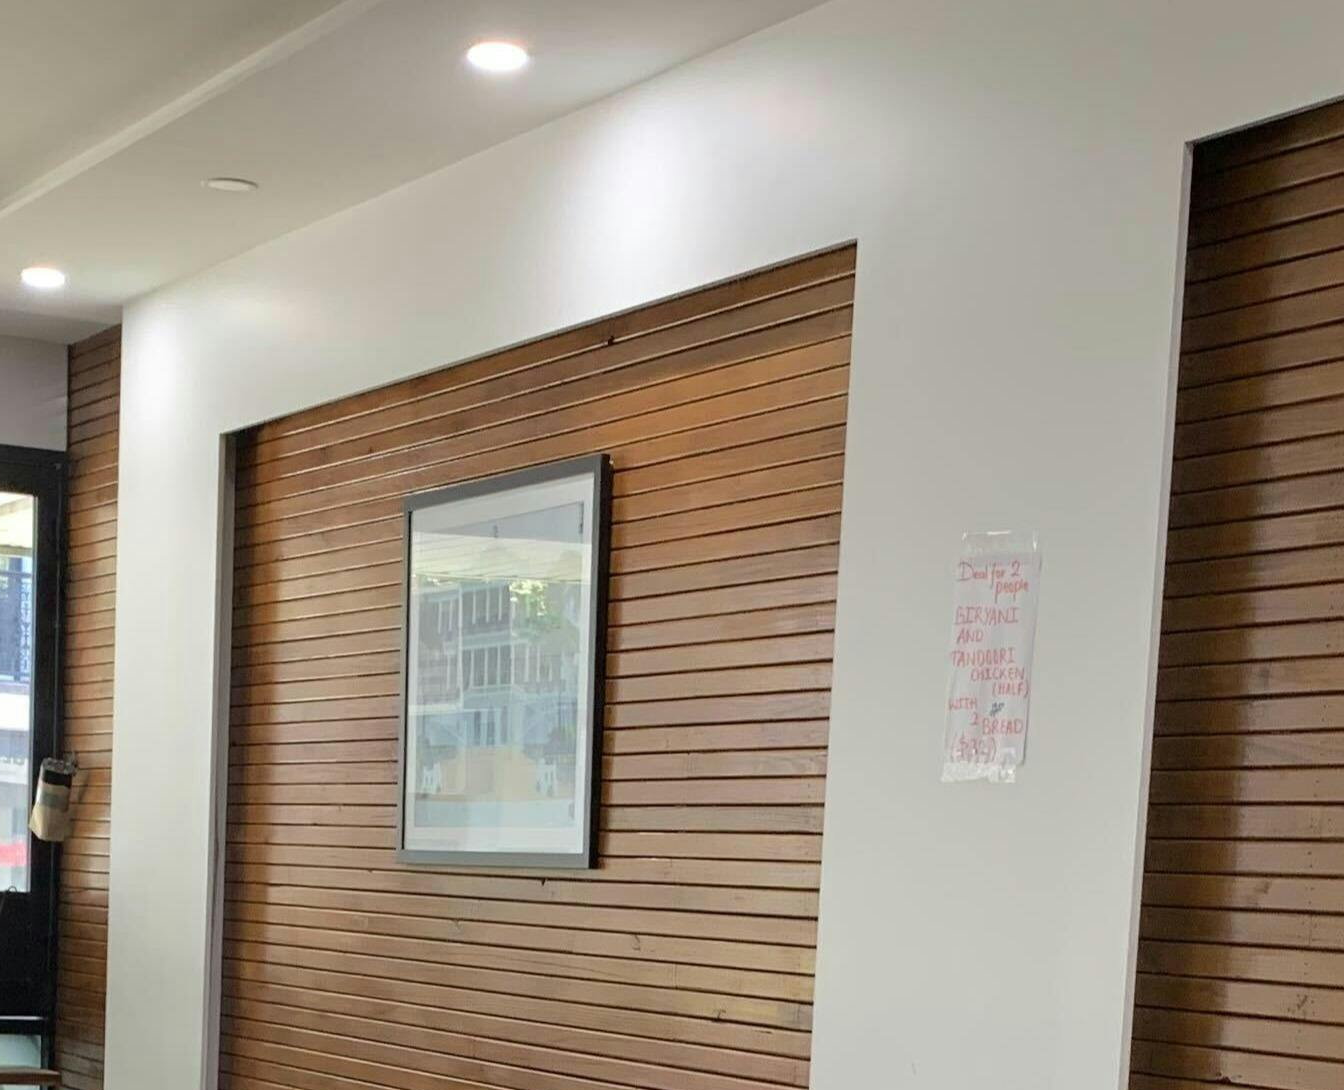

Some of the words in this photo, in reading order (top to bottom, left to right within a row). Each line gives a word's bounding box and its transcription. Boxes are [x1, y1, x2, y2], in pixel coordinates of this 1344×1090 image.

[990, 562, 1005, 590] for
[1010, 560, 1021, 576] 2
[995, 579, 1029, 604] people
[955, 605, 1020, 626] BIRYANI
[957, 627, 984, 645] AND
[951, 646, 1016, 667] TANDOORI
[970, 665, 1025, 681] CHICKEN
[949, 697, 977, 711] WITH
[982, 718, 1023, 735] BREAD
